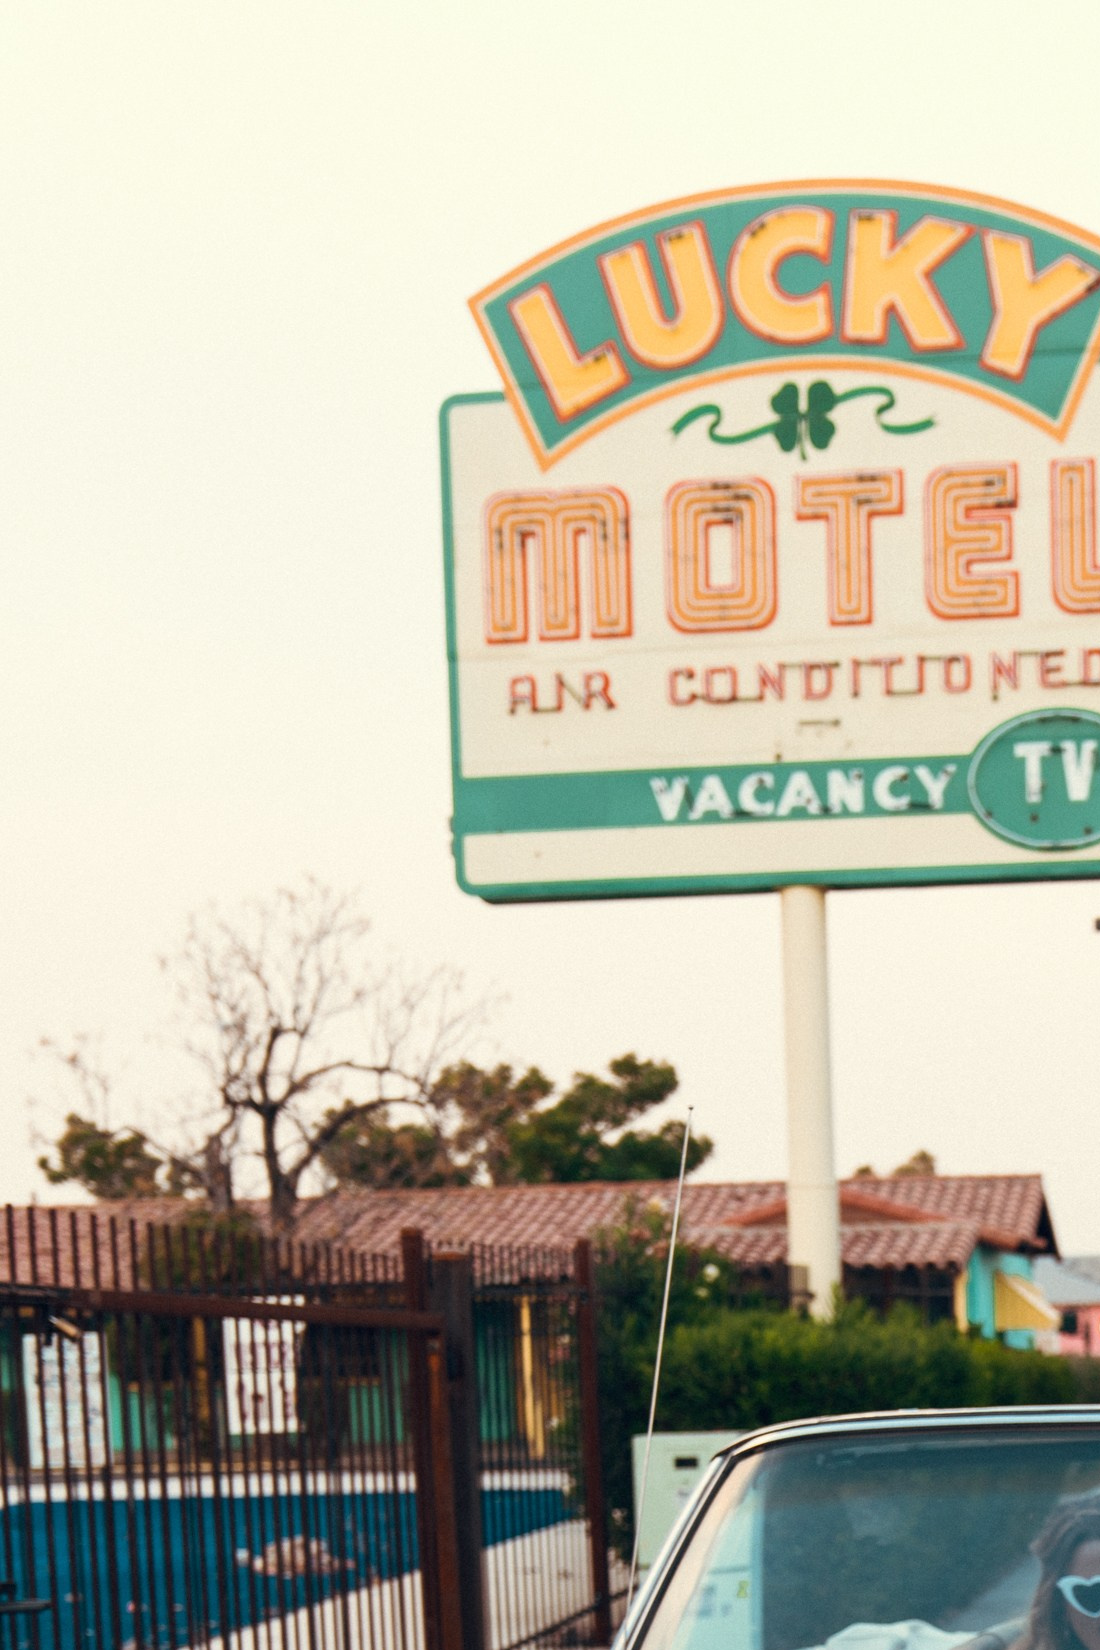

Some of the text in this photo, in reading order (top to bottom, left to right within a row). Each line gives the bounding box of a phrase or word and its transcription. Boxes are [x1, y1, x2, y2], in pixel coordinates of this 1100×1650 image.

[509, 671, 617, 714] AIR
[649, 764, 957, 821] VACANCY
[1013, 741, 1098, 803] TV
